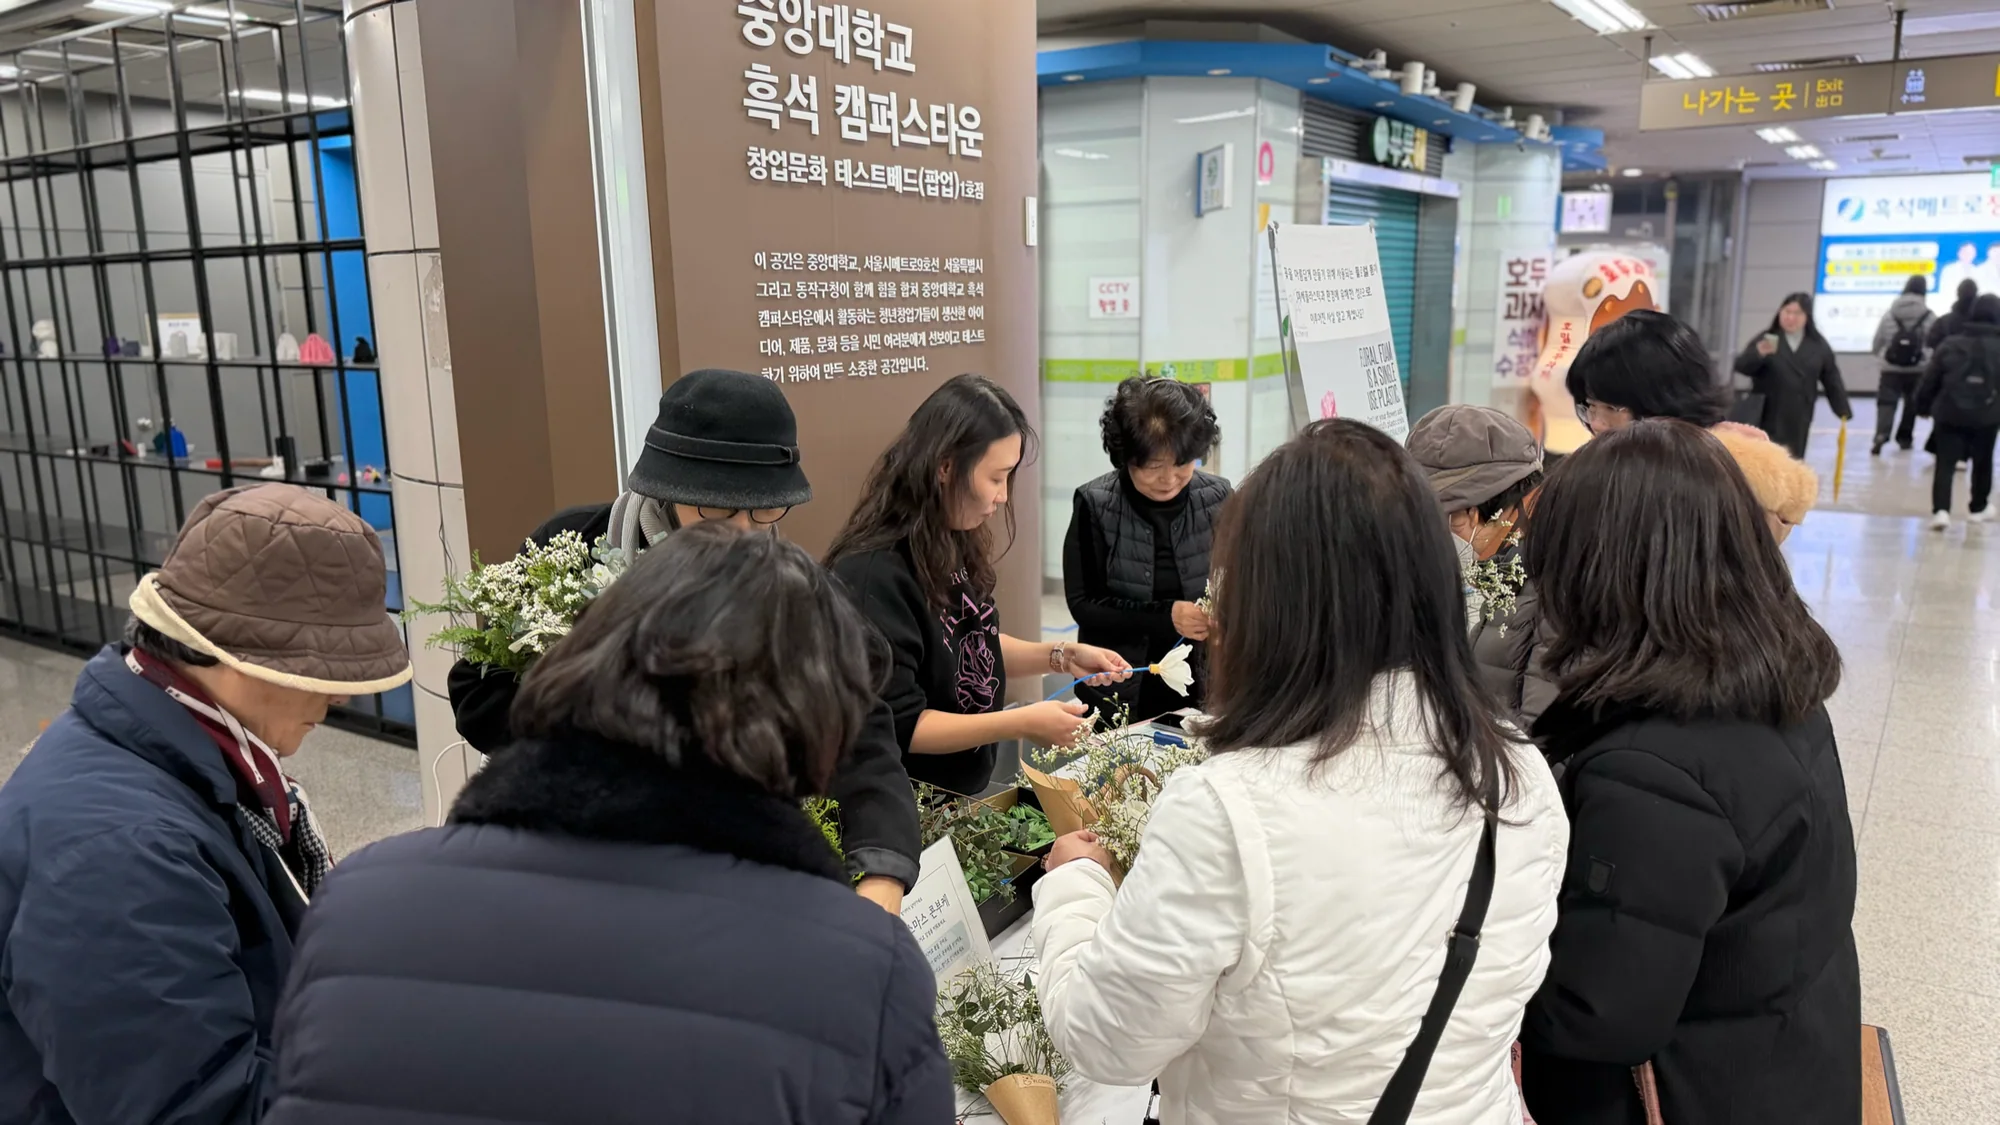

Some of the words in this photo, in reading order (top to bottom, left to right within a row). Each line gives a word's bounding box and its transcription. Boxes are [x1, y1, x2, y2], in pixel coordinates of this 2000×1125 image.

[737, 0, 916, 73] 중앙대학교
[1816, 78, 1844, 92] Exit
[743, 62, 820, 136] 흑석
[834, 83, 984, 158] 캠퍼스타운
[1682, 86, 1761, 116] 나가는
[1769, 82, 1797, 111] 곳
[1816, 94, 1843, 108] 出口
[746, 145, 829, 187] 창업문화
[754, 251, 767, 270] 이
[770, 252, 804, 271] 공간은
[807, 253, 861, 273] 중앙대학교,
[863, 255, 940, 273] 서울시메트로9호선
[943, 257, 984, 274] 서울특별시
[1505, 257, 1546, 287] 호두
[756, 282, 792, 298] 그리고
[795, 281, 850, 299] 동작구청이
[853, 281, 874, 298] 함께
[877, 282, 897, 298] 힘을
[899, 282, 919, 298] 합쳐
[921, 282, 965, 298] 중앙대학교
[967, 281, 984, 297] 흑석
[1098, 282, 1130, 294] CCTV
[758, 308, 834, 328] 캠퍼스타운에서
[837, 307, 876, 326] 활동하는
[879, 306, 939, 324] 청년창업가들이
[941, 305, 966, 322] 생산한
[967, 305, 984, 321] 아이
[759, 338, 786, 357] 디어,
[789, 336, 814, 355] 제품,
[816, 335, 838, 353] 문화
[839, 334, 860, 352] 등을
[862, 333, 882, 351] 시민
[883, 331, 926, 349] 여러분에게
[928, 330, 960, 347] 선보이고
[962, 329, 986, 344] 테스트
[761, 365, 785, 384] 하기
[788, 363, 821, 383] 위하여
[847, 359, 877, 378] 소중한
[880, 356, 929, 375] 공간입니다.
[1495, 352, 1538, 378] 수정
[928, 893, 951, 919] 콘부케
